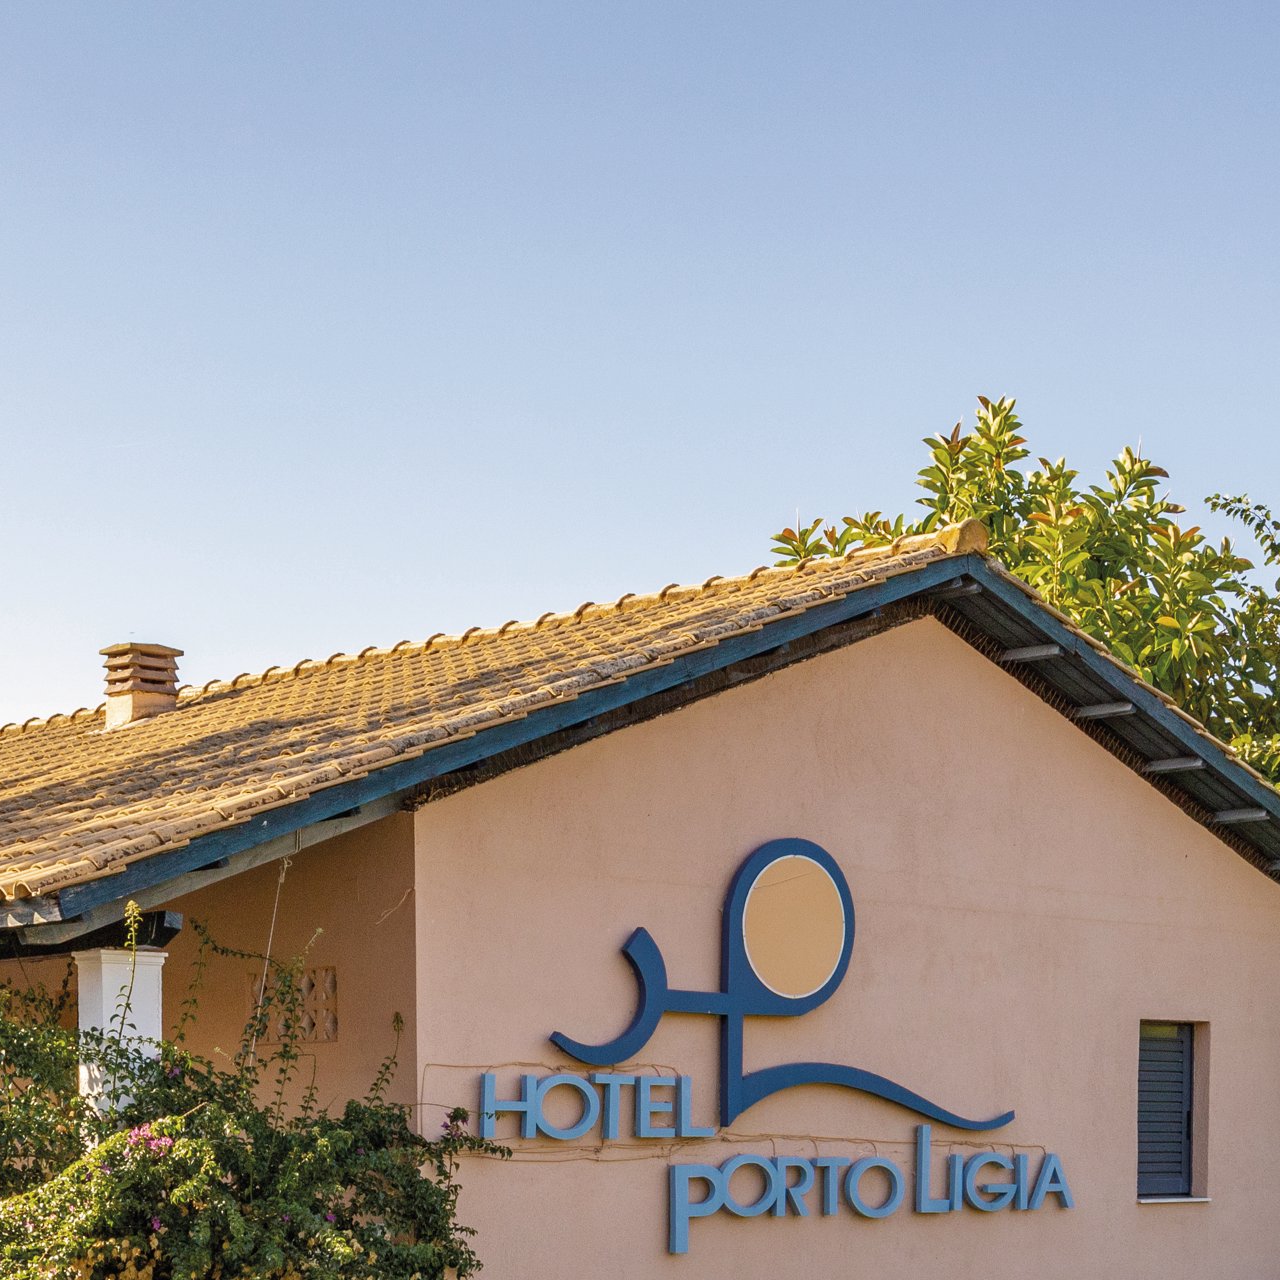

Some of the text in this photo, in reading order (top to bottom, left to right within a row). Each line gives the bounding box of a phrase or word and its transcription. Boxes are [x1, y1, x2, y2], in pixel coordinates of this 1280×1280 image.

[480, 1072, 716, 1141] HOTEL
[669, 1124, 1075, 1254] PORTO LIGIA
